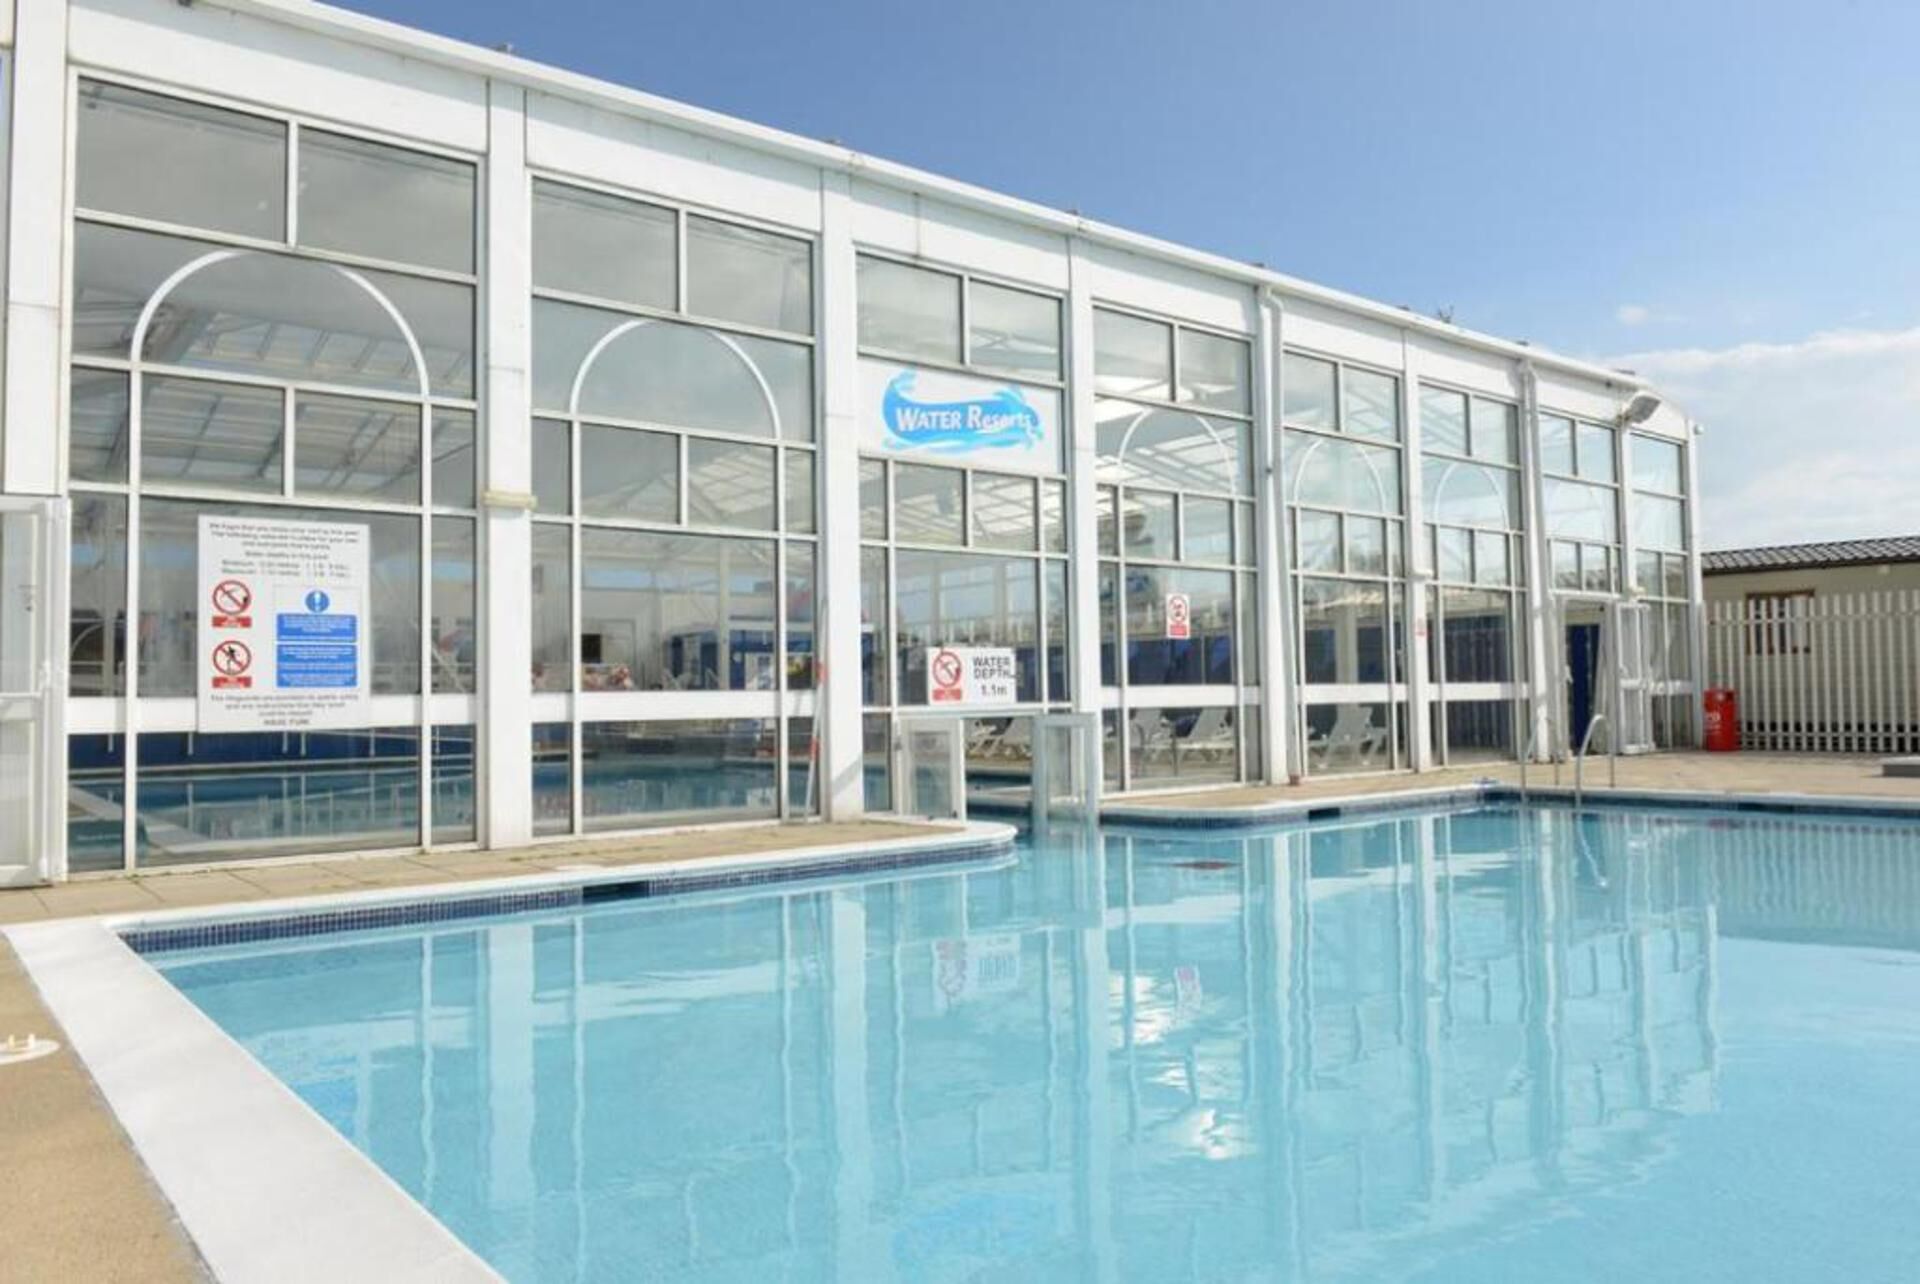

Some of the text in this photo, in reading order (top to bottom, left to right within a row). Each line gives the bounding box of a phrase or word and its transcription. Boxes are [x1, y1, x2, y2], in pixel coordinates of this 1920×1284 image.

[895, 406, 961, 432] WATER
[972, 655, 1010, 667] WATER
[973, 668, 1010, 679] DEPTH
